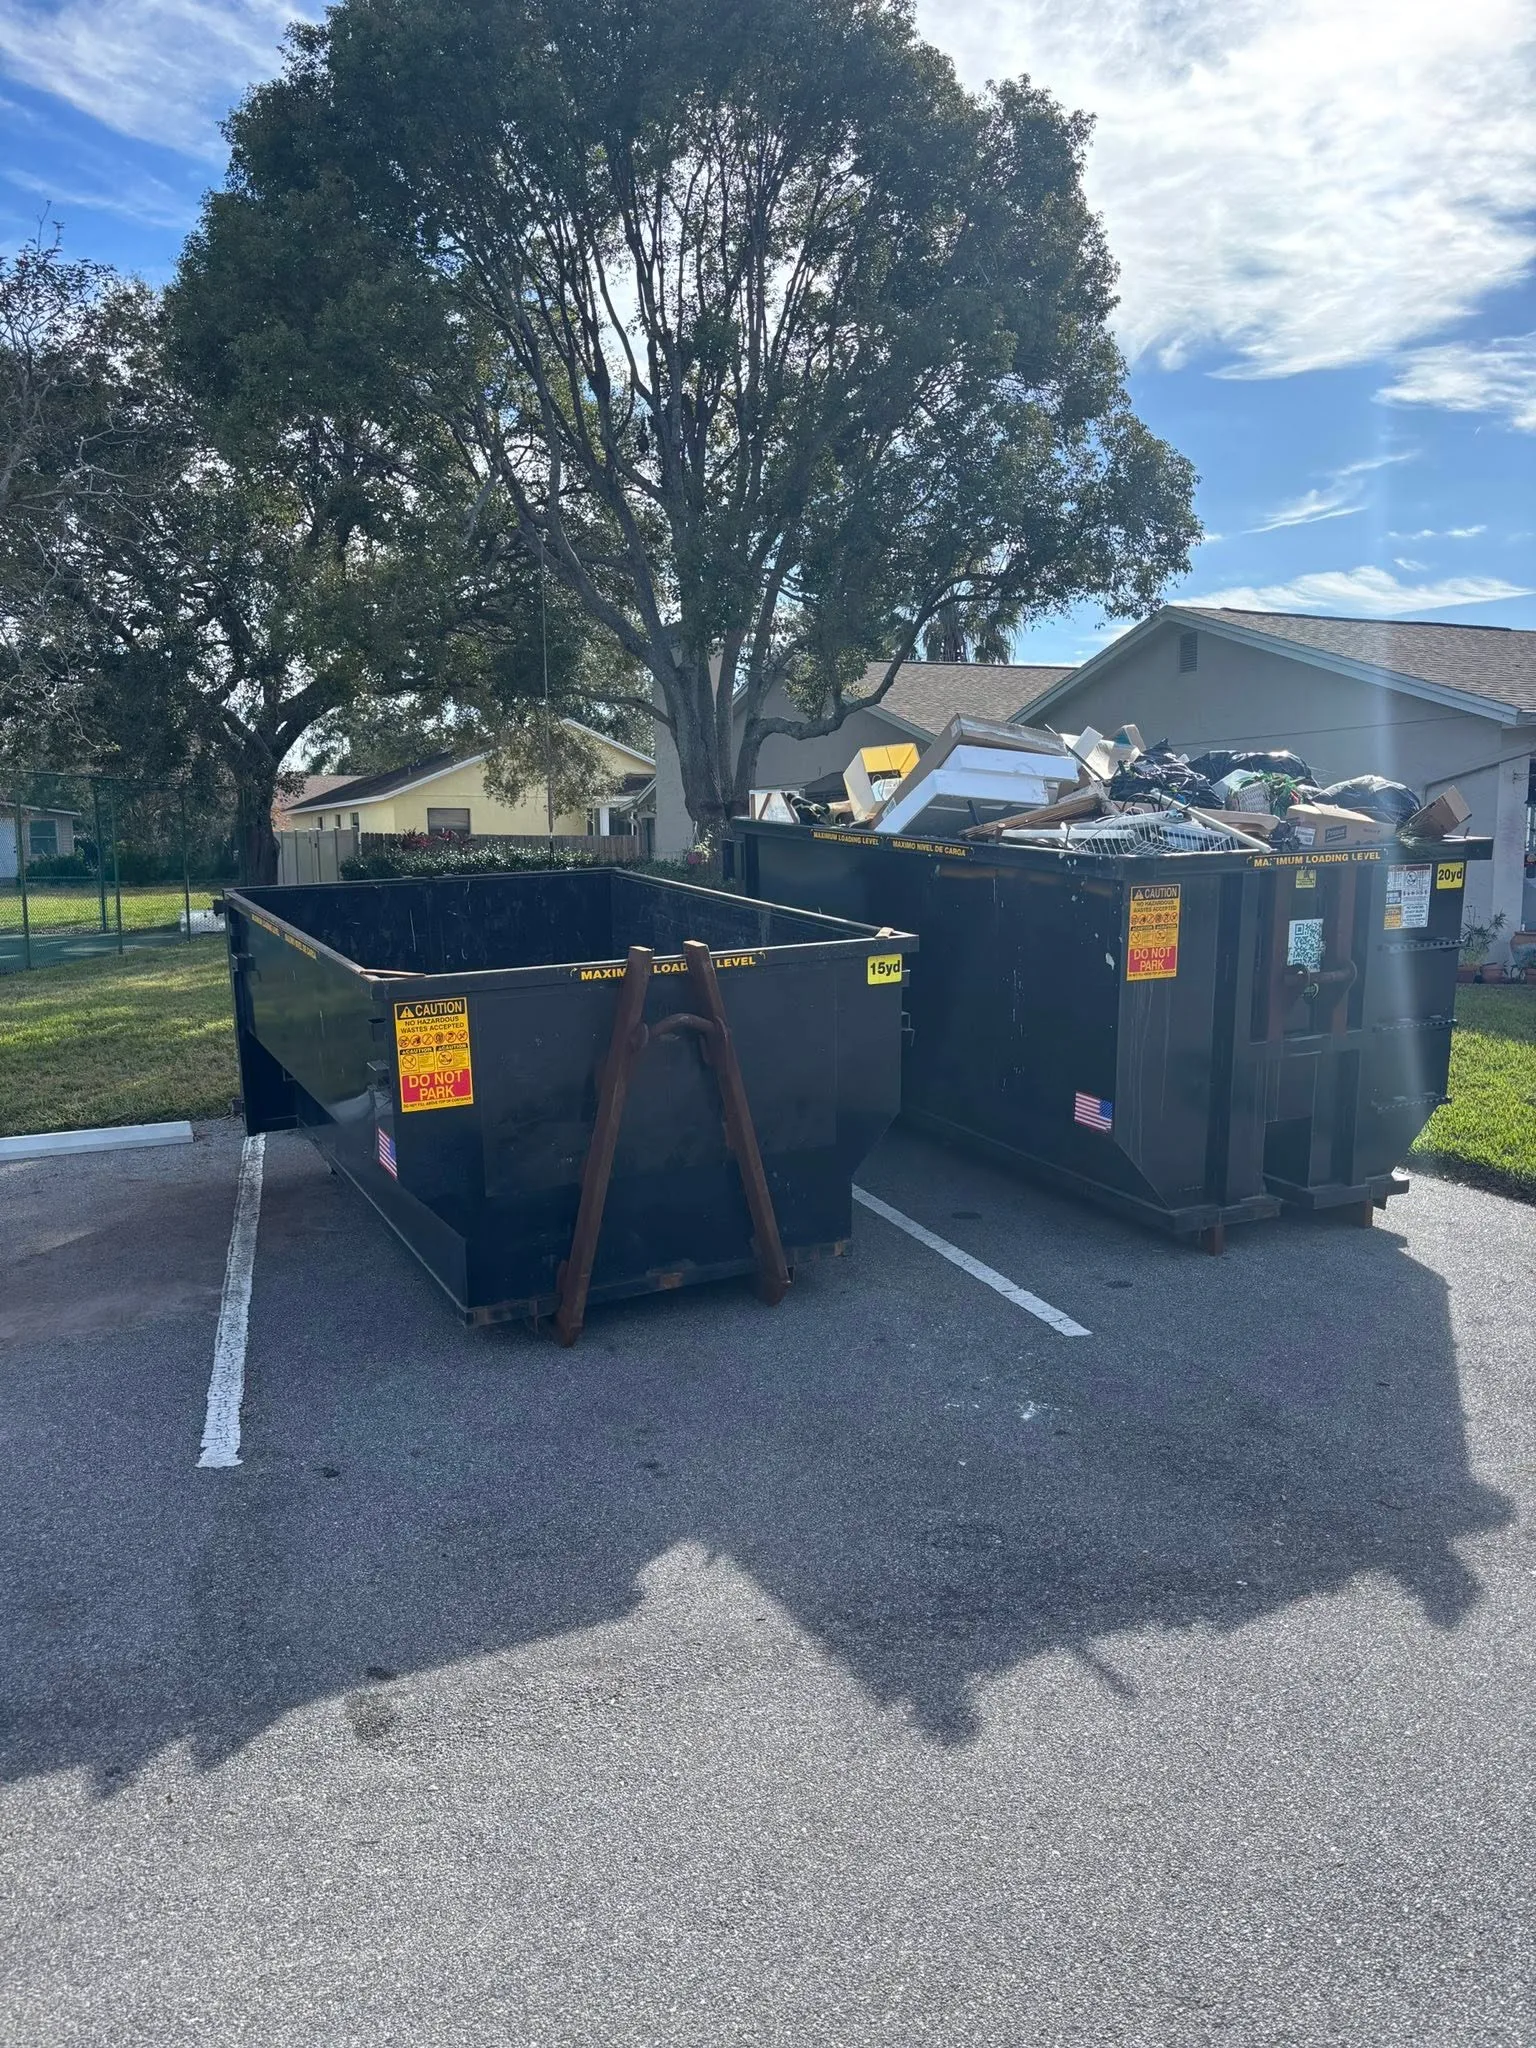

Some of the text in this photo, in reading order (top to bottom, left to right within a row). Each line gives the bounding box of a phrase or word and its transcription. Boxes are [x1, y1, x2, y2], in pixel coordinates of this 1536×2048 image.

[862, 837, 879, 845] LEVEL
[917, 843, 934, 852] NIVEL
[935, 845, 943, 853] DE
[1306, 854, 1348, 864] LOADING
[1352, 852, 1381, 861] LEVEL
[1438, 867, 1463, 882] 20yd
[1144, 887, 1177, 899] CAUTION
[1134, 947, 1172, 960] DO NOT
[580, 956, 756, 980] MAXIM LOAD LEVEL
[870, 960, 900, 976] 15yd
[1140, 960, 1165, 971] PARK
[415, 1001, 462, 1016] CAUTION
[417, 1016, 459, 1025] HAZARDOUS
[401, 1022, 464, 1034] WASTES ACCEPTED
[409, 1070, 463, 1088] DO NOT
[420, 1085, 455, 1100] PARK
